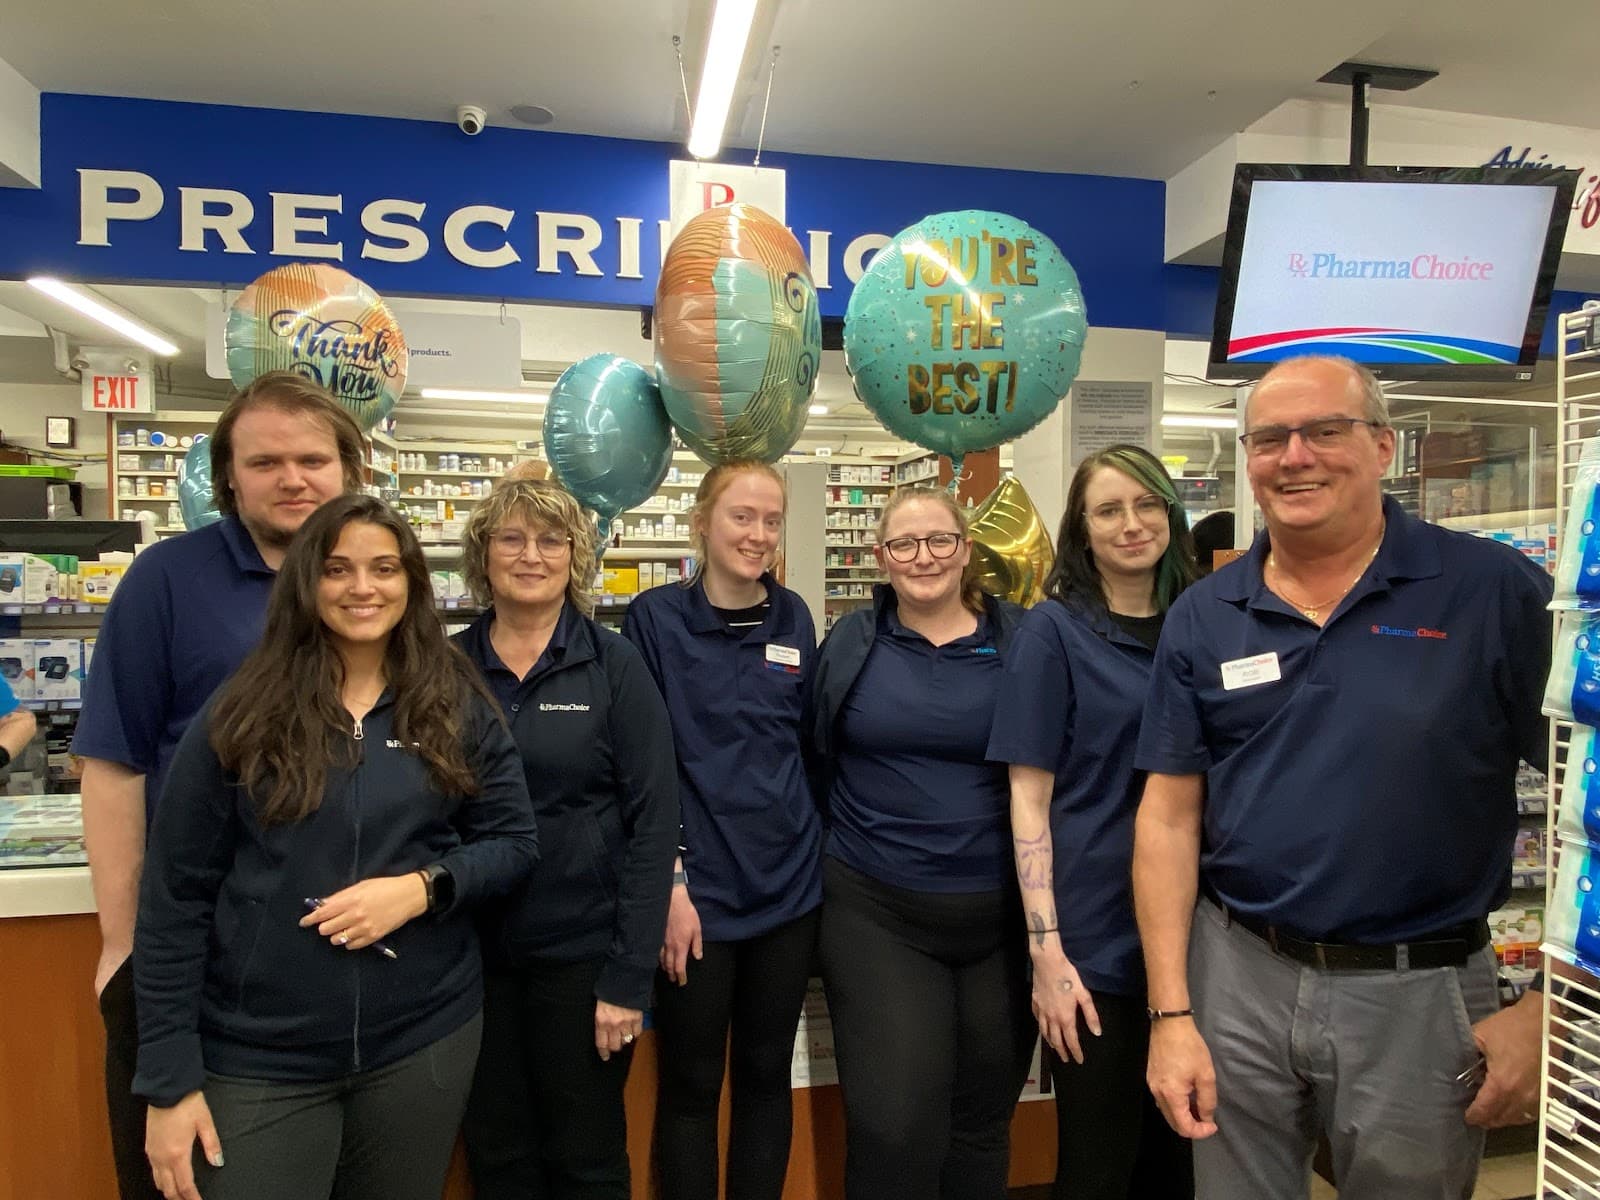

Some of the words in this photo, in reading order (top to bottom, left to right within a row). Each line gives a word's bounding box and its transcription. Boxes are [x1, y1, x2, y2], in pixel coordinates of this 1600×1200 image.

[903, 229, 1039, 290] YOU'RE
[1309, 252, 1495, 281] PharmaChoice
[269, 308, 399, 378] Thank
[924, 292, 1006, 351] THE
[411, 348, 452, 357] products.
[93, 375, 139, 409] EXIT
[907, 361, 1020, 415] BEST!
